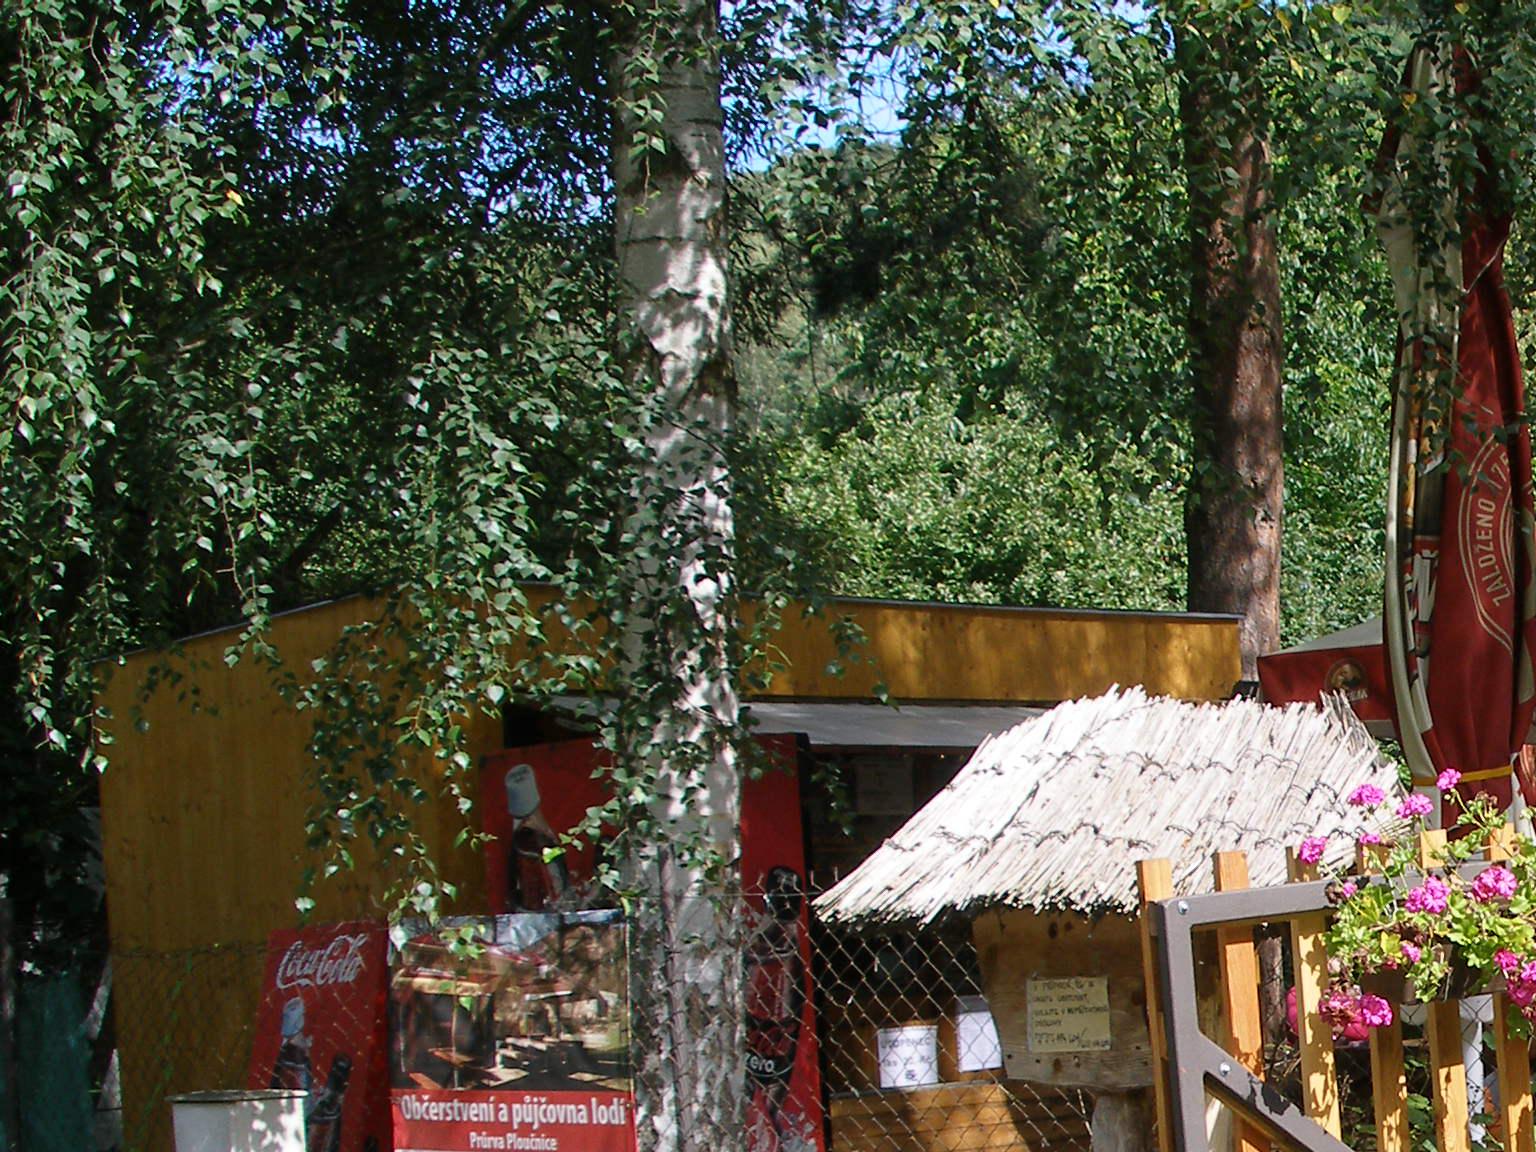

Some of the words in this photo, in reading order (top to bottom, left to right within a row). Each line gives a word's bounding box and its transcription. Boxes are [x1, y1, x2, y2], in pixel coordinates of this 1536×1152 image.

[1475, 497, 1511, 607] ZALOŽENO
[401, 1094, 496, 1122] Občerstvení
[498, 1105, 508, 1123] a
[512, 1096, 588, 1129] půjčovna
[591, 1098, 626, 1125] lodí
